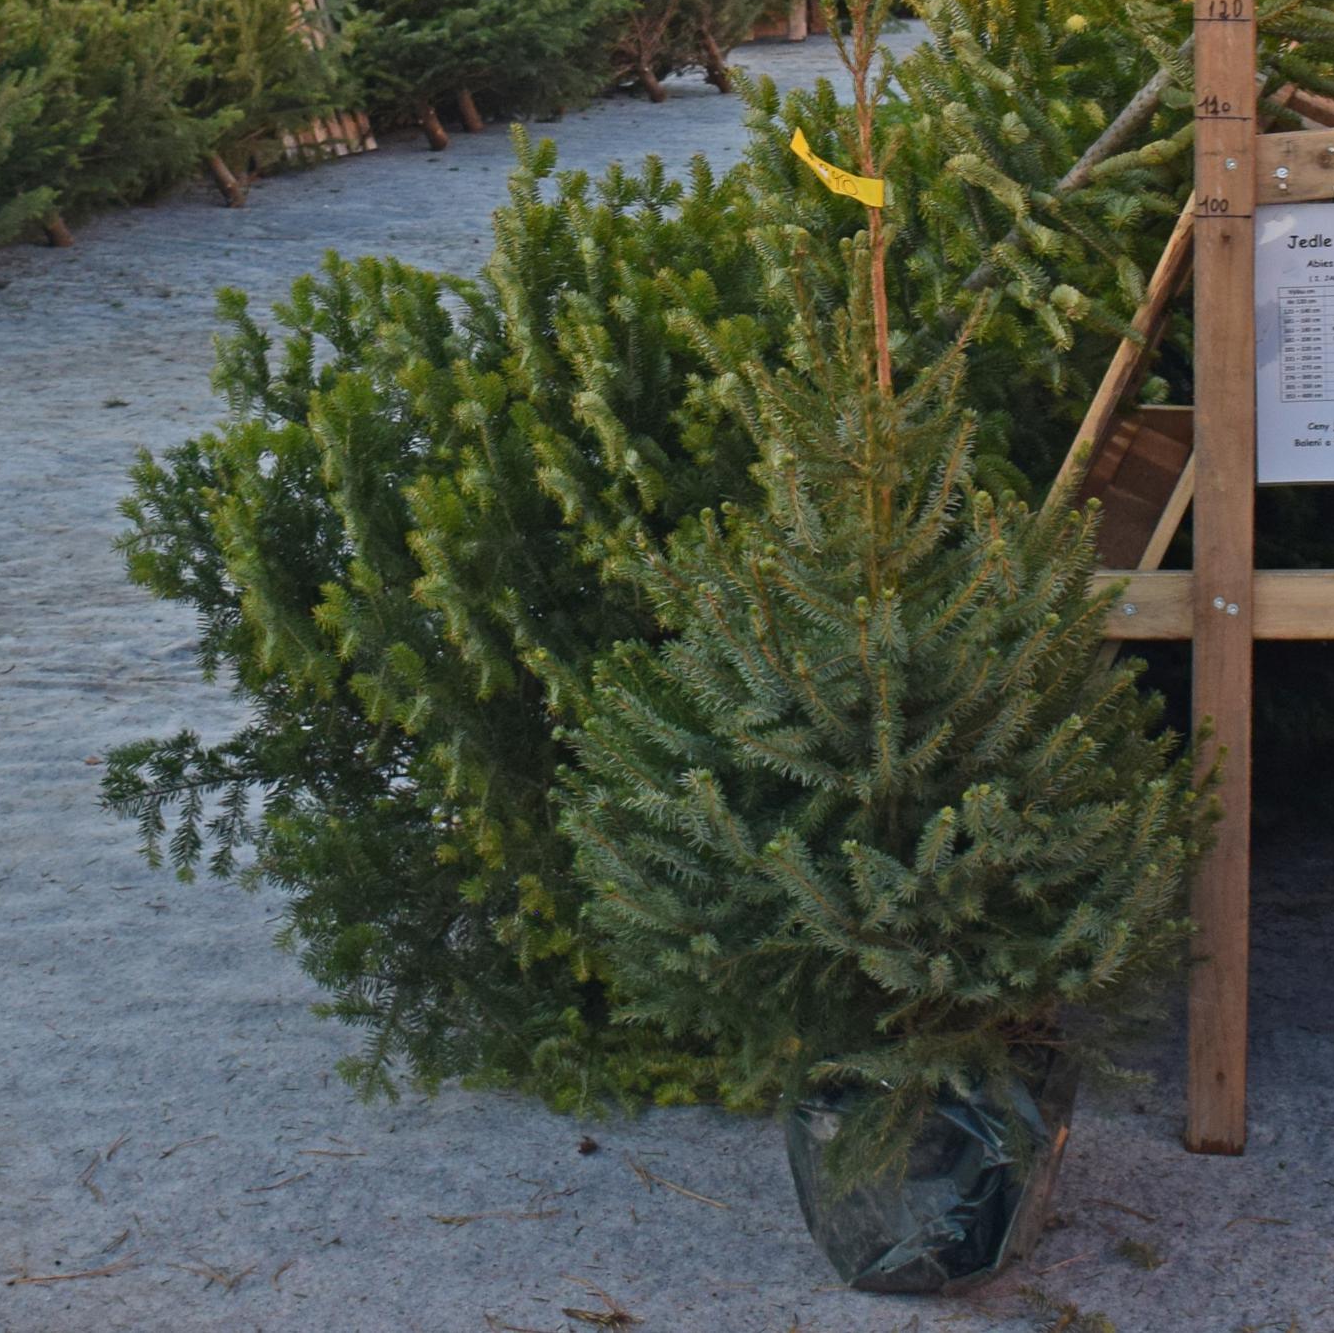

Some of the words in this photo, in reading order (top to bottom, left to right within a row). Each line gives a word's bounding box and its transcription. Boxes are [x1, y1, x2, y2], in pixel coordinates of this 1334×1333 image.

[1197, 94, 1231, 115] 110
[1198, 194, 1229, 213] 100
[1287, 234, 1333, 249] Jedle
[1307, 422, 1329, 432] Ceny
